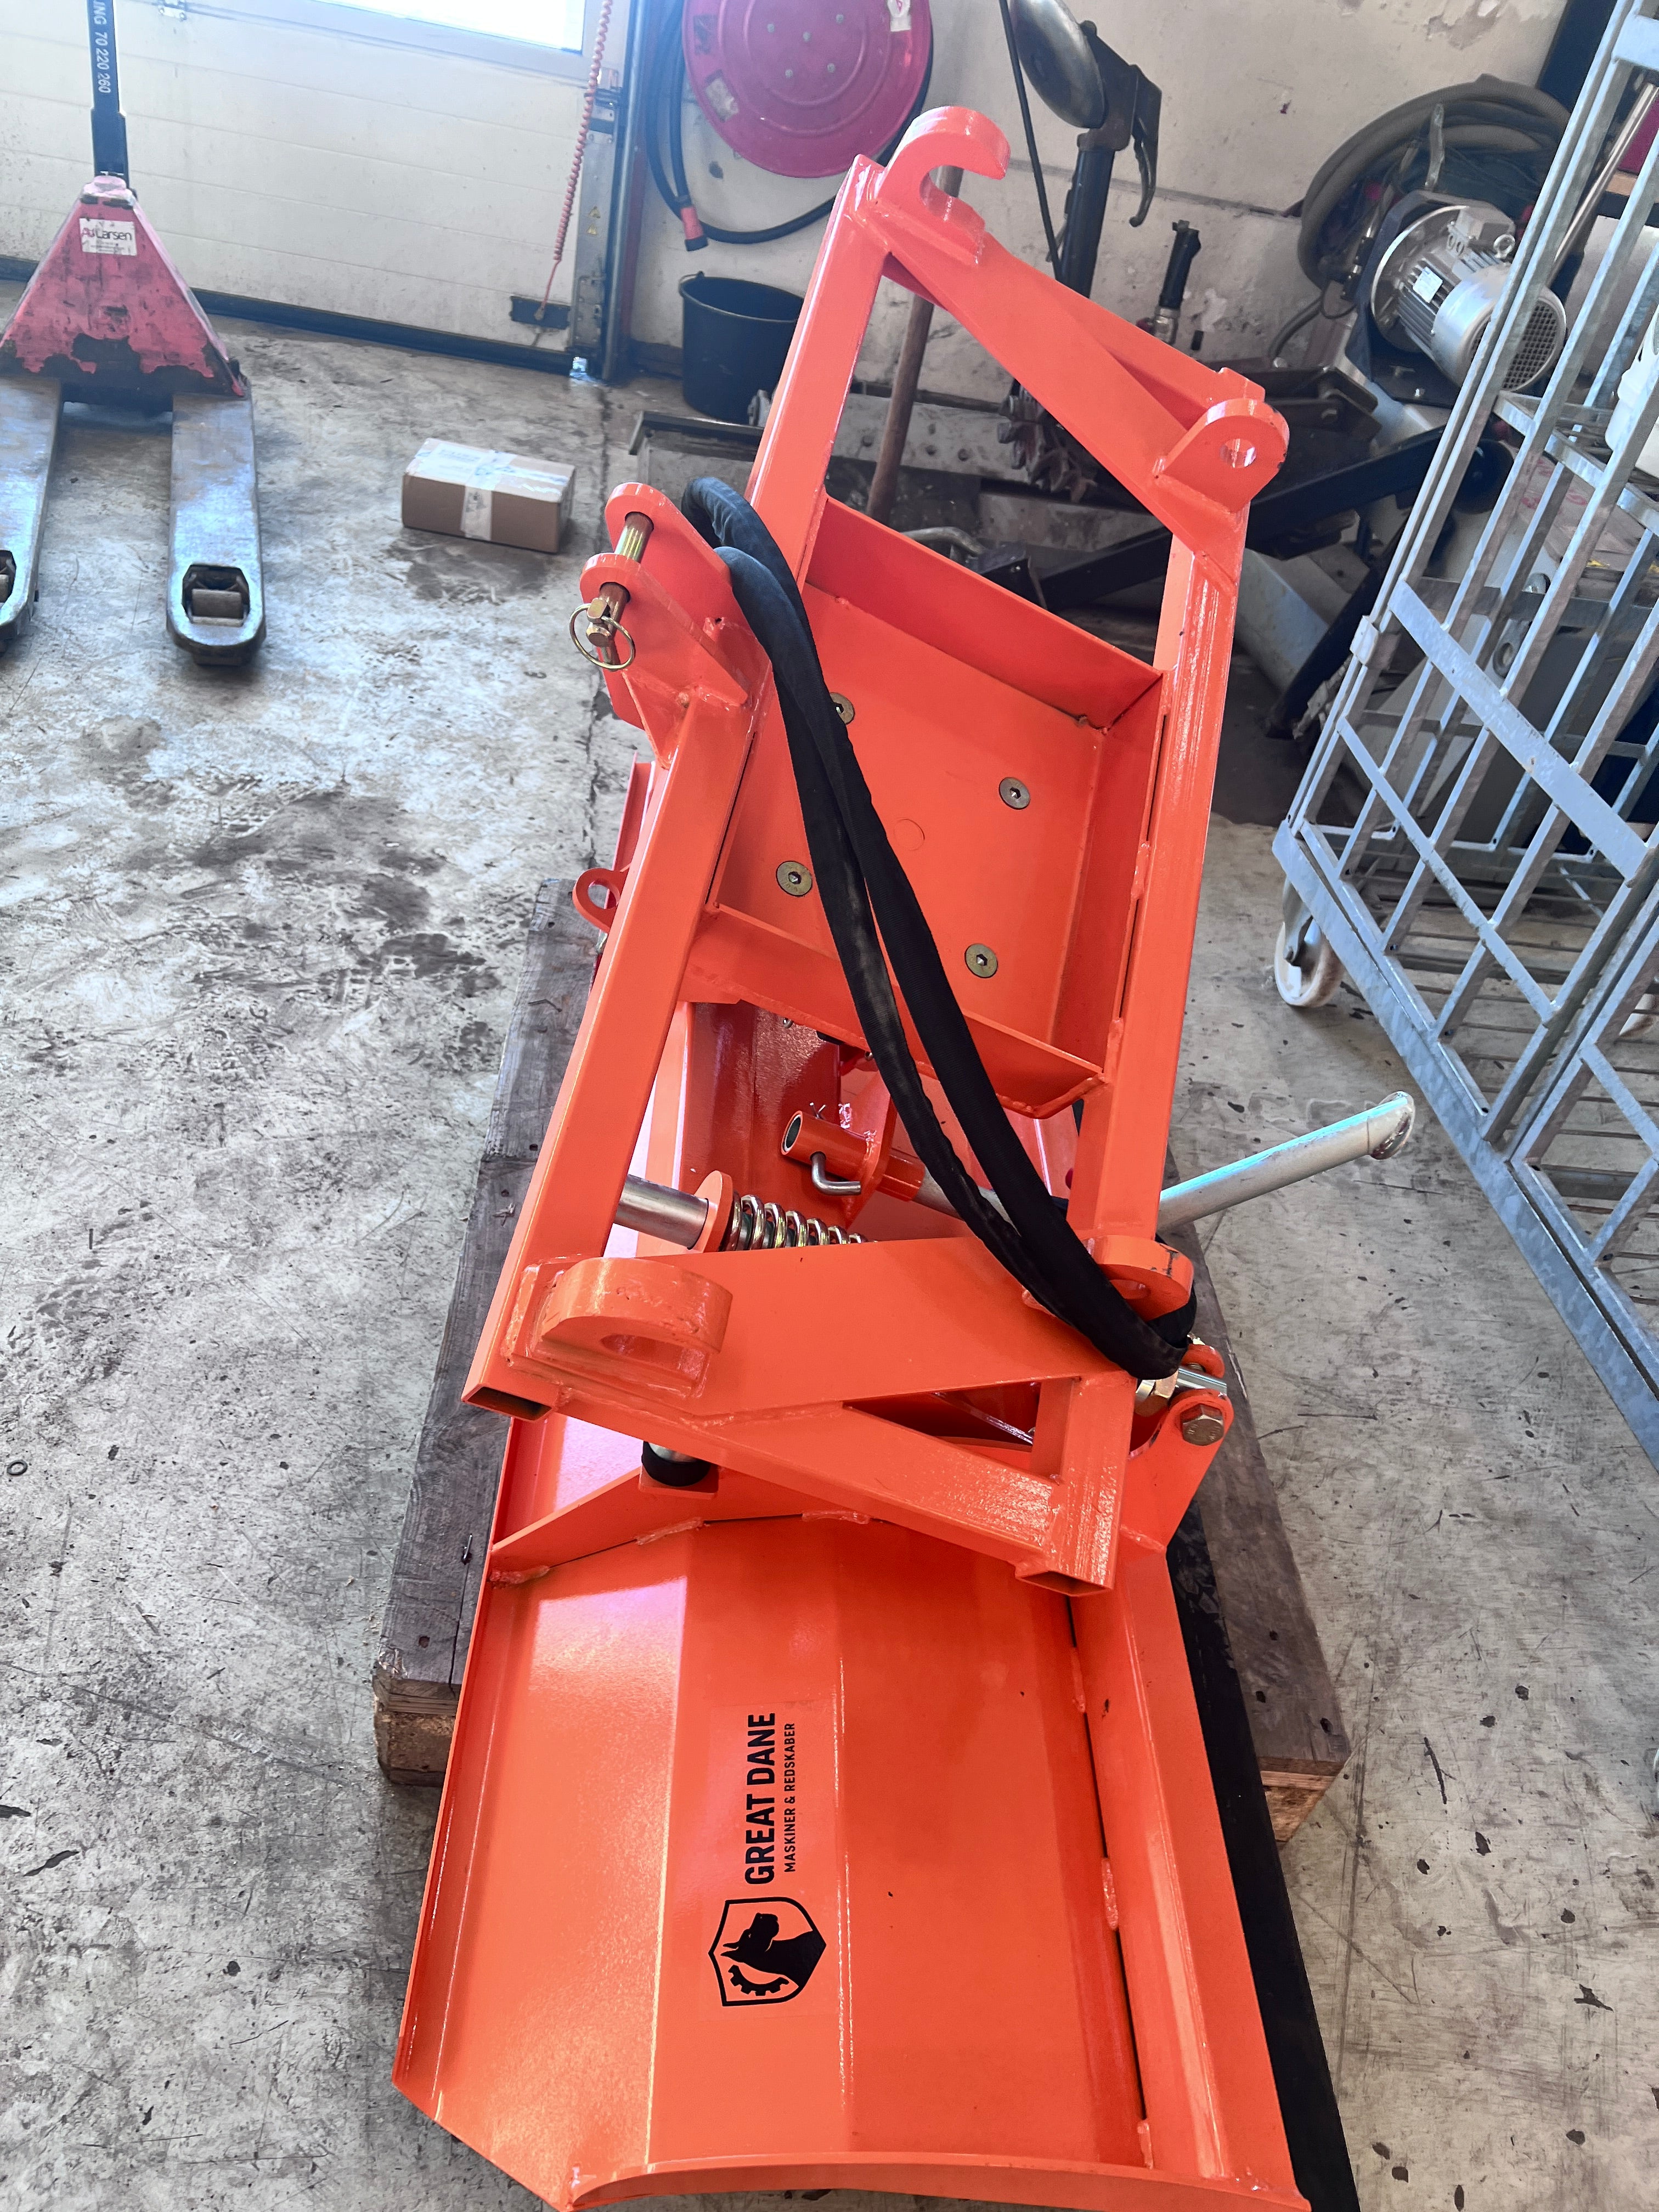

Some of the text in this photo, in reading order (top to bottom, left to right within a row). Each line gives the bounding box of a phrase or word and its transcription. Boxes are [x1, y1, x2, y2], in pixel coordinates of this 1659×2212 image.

[93, 0, 111, 94] ING 70 220 260
[95, 229, 133, 241] Larsen
[744, 1713, 775, 1884] GREAT DANE
[784, 1723, 795, 1872] MASKINER & REDSKABER
